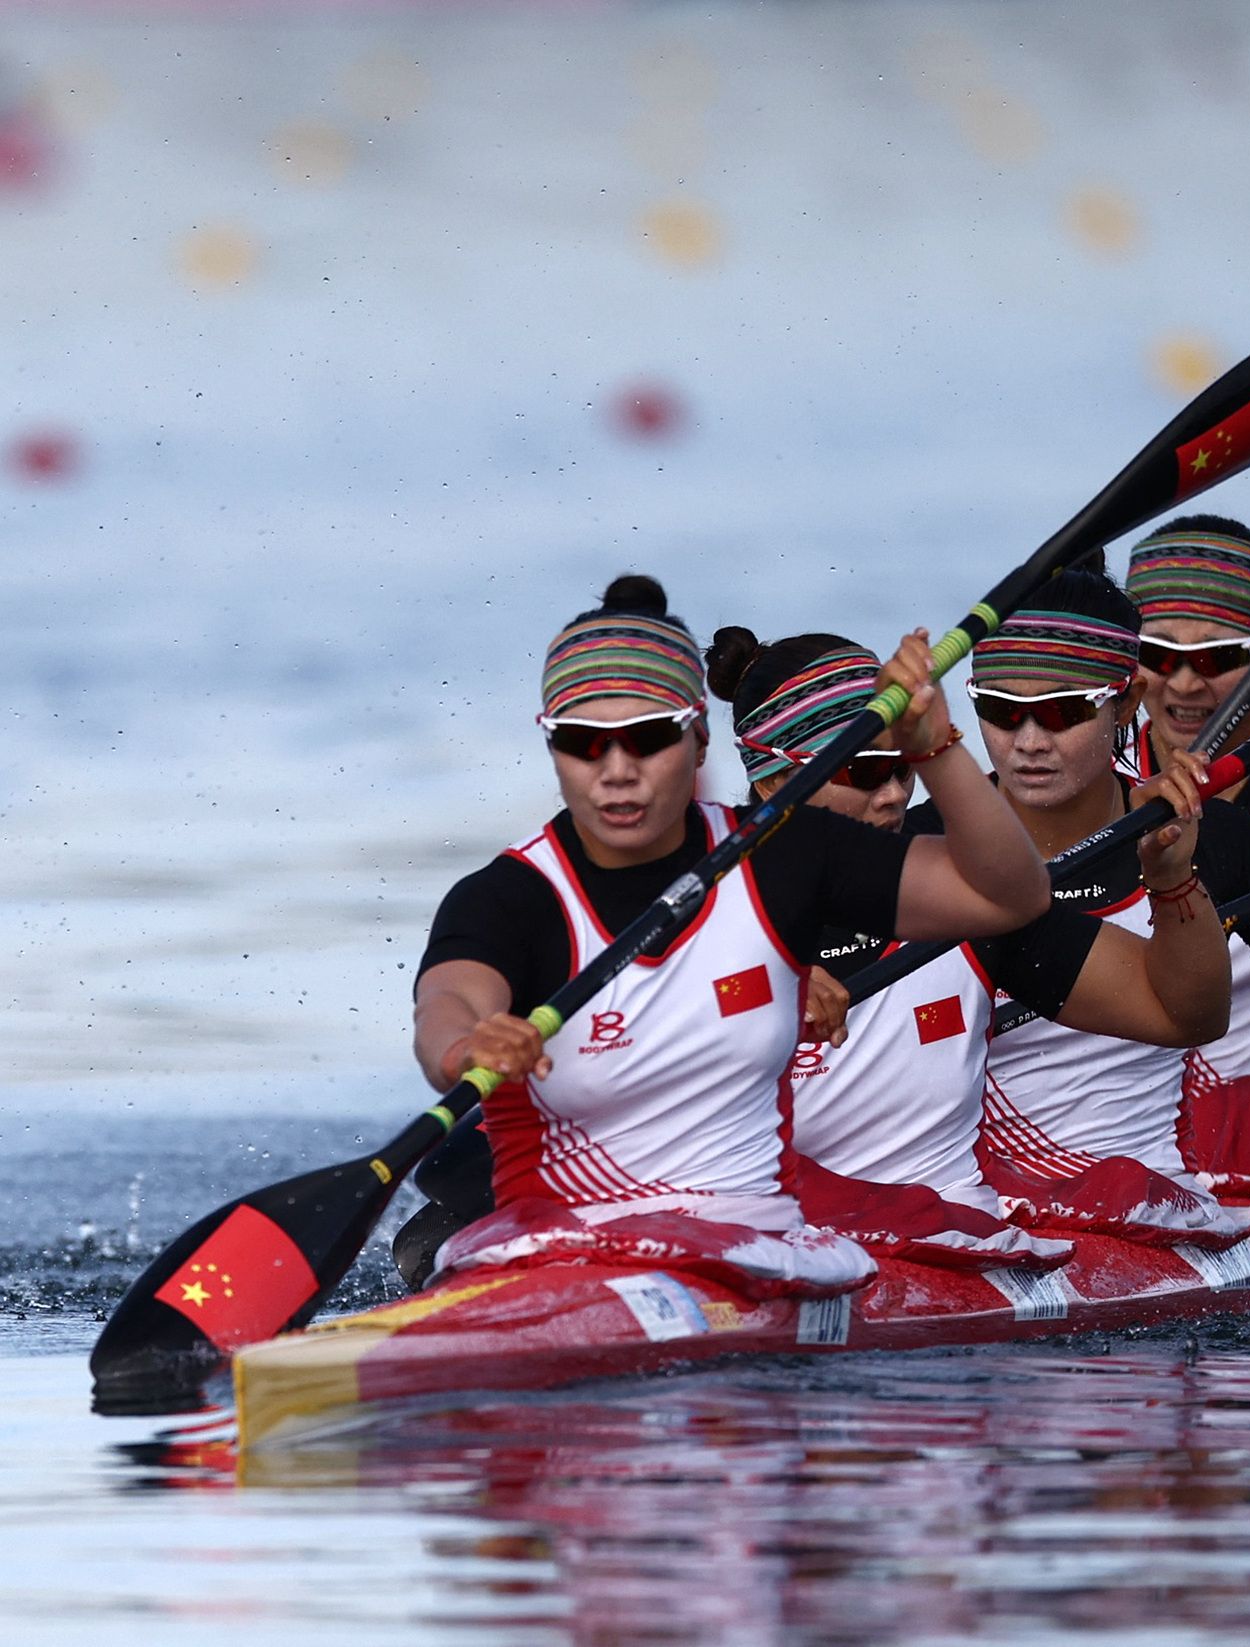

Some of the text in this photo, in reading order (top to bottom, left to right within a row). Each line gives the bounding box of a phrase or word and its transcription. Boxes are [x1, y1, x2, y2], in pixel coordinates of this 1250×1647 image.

[1207, 731, 1228, 757] ARIS
[1088, 829, 1114, 843] 2024
[1052, 887, 1092, 899] RAFT
[789, 1066, 830, 1080] DYWRAP
